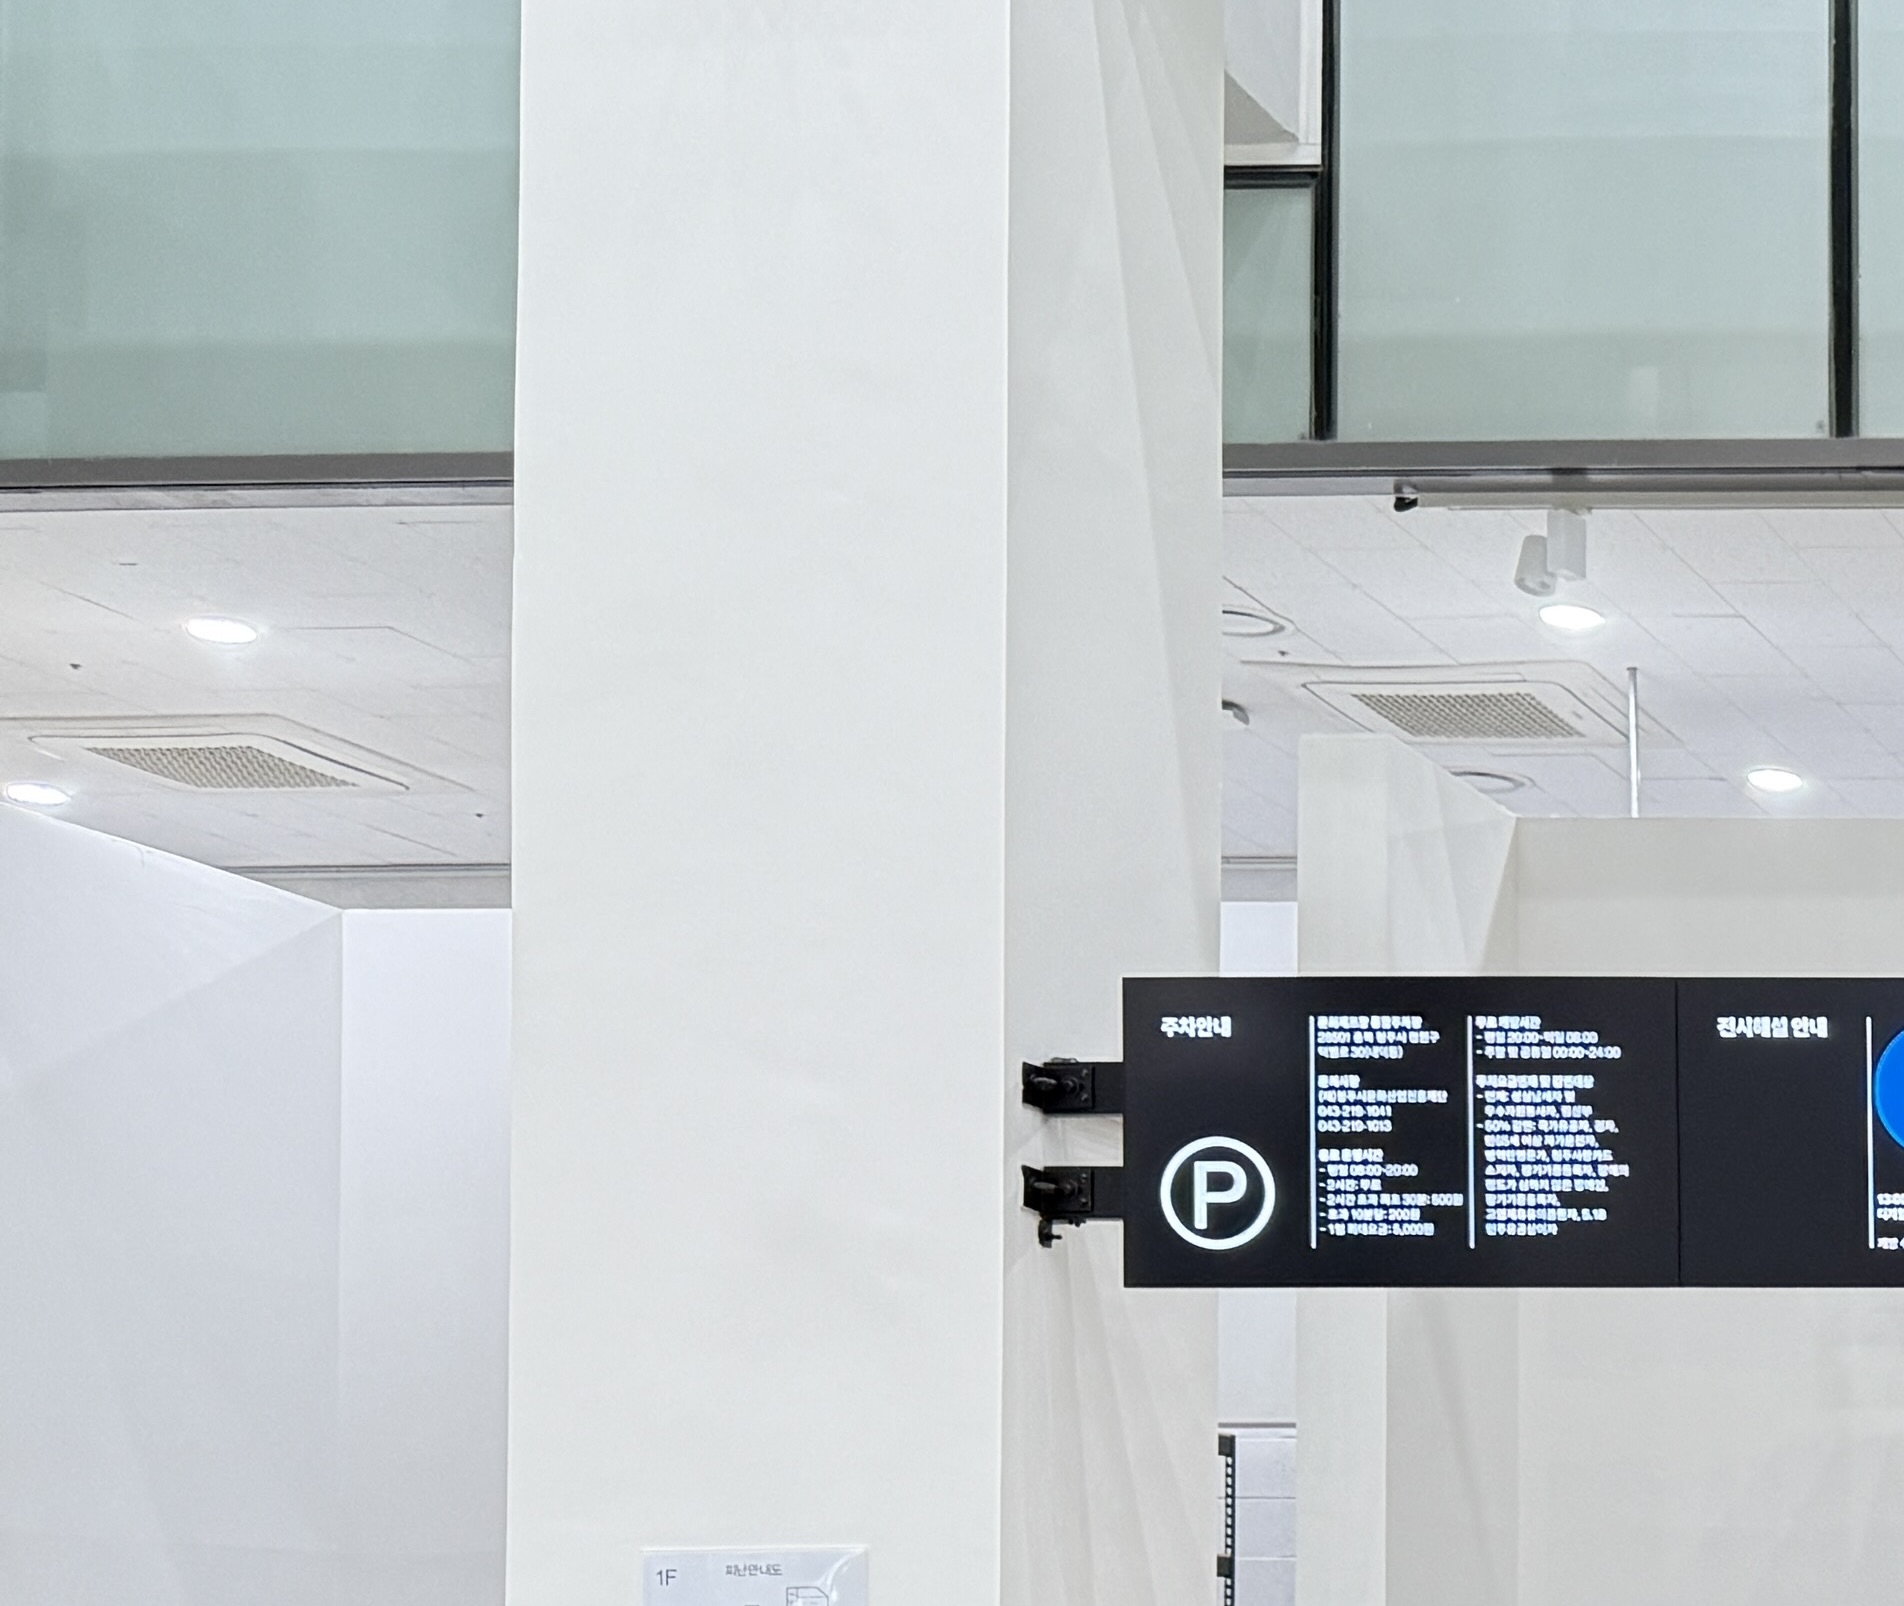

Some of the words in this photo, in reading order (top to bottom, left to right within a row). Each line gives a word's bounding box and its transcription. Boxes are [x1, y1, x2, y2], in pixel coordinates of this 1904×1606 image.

[1161, 1016, 1231, 1037] 주차안내
[1791, 1016, 1828, 1038] 안내
[656, 1569, 677, 1587] 1F
